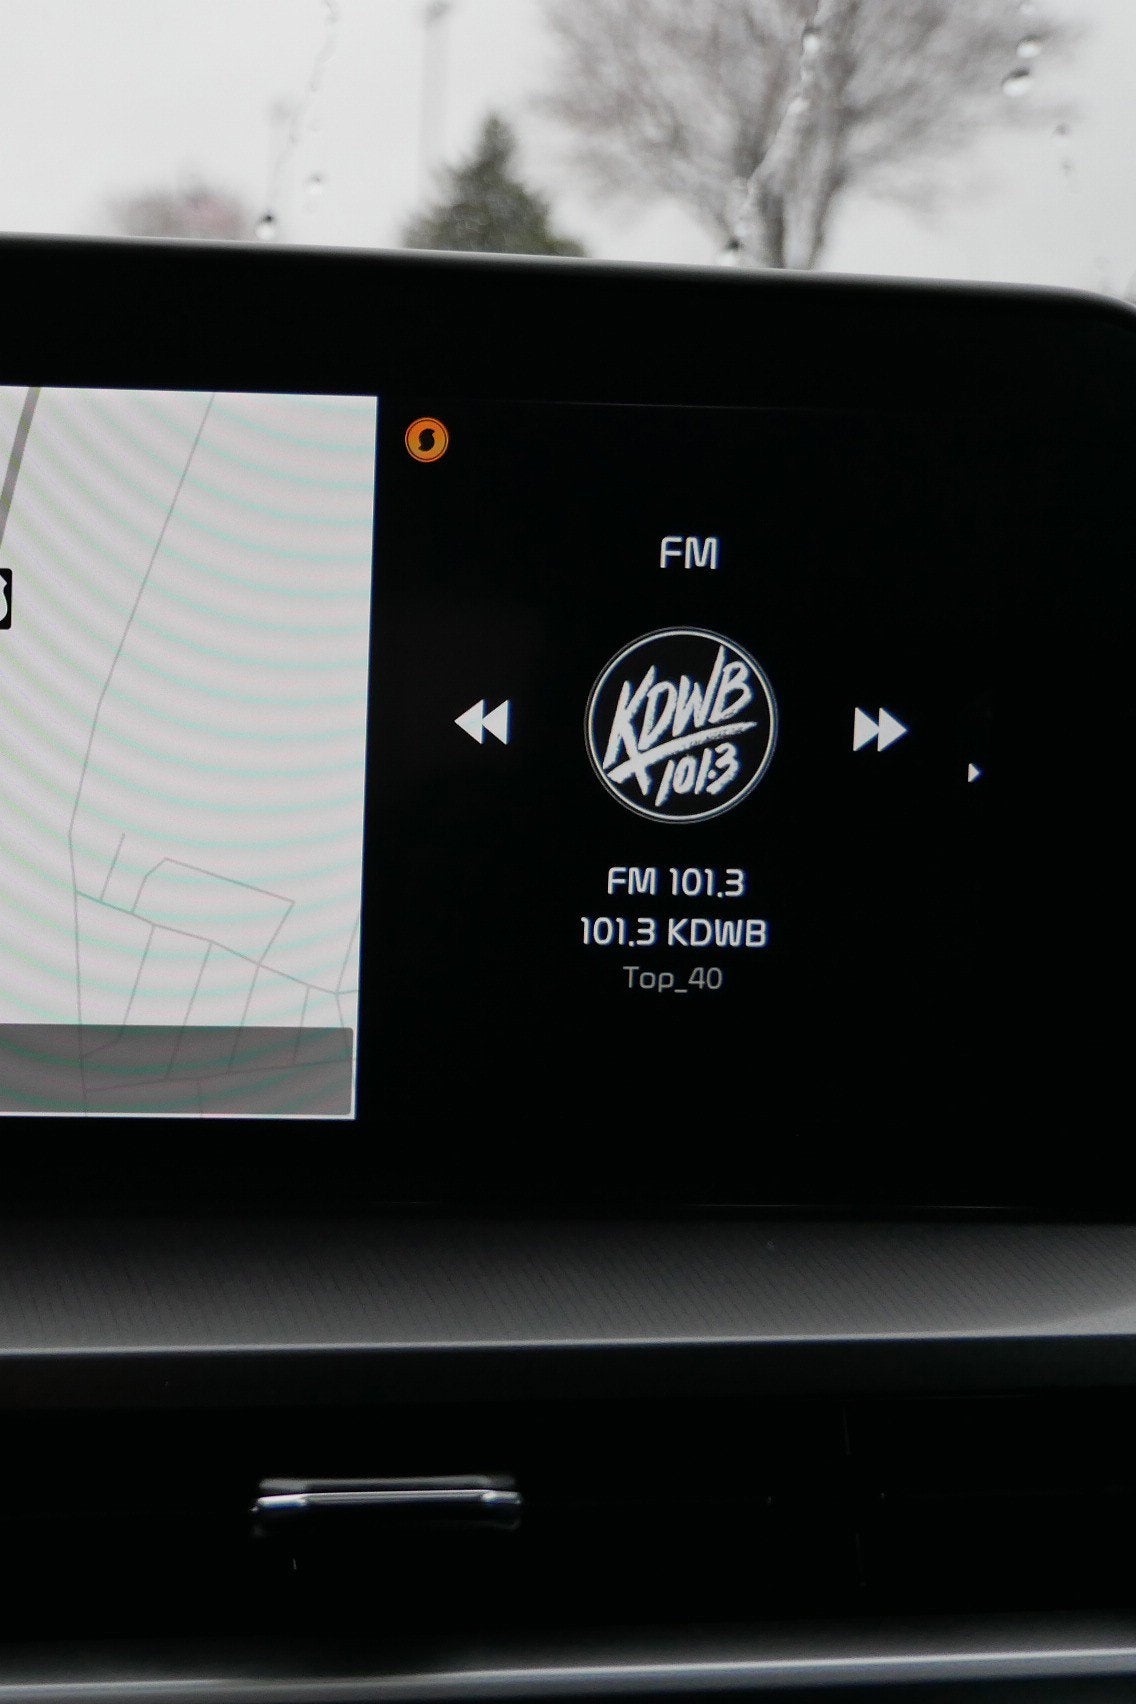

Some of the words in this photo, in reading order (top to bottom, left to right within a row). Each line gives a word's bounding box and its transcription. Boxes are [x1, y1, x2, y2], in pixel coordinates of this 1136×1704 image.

[659, 536, 718, 570] FM
[603, 646, 754, 793] KDWB
[655, 743, 738, 807] 101.3
[607, 867, 656, 895] FM
[669, 868, 745, 898] 101.3
[581, 917, 656, 946] 101.3
[667, 919, 766, 947] KDWB
[623, 966, 723, 994] Top_40
